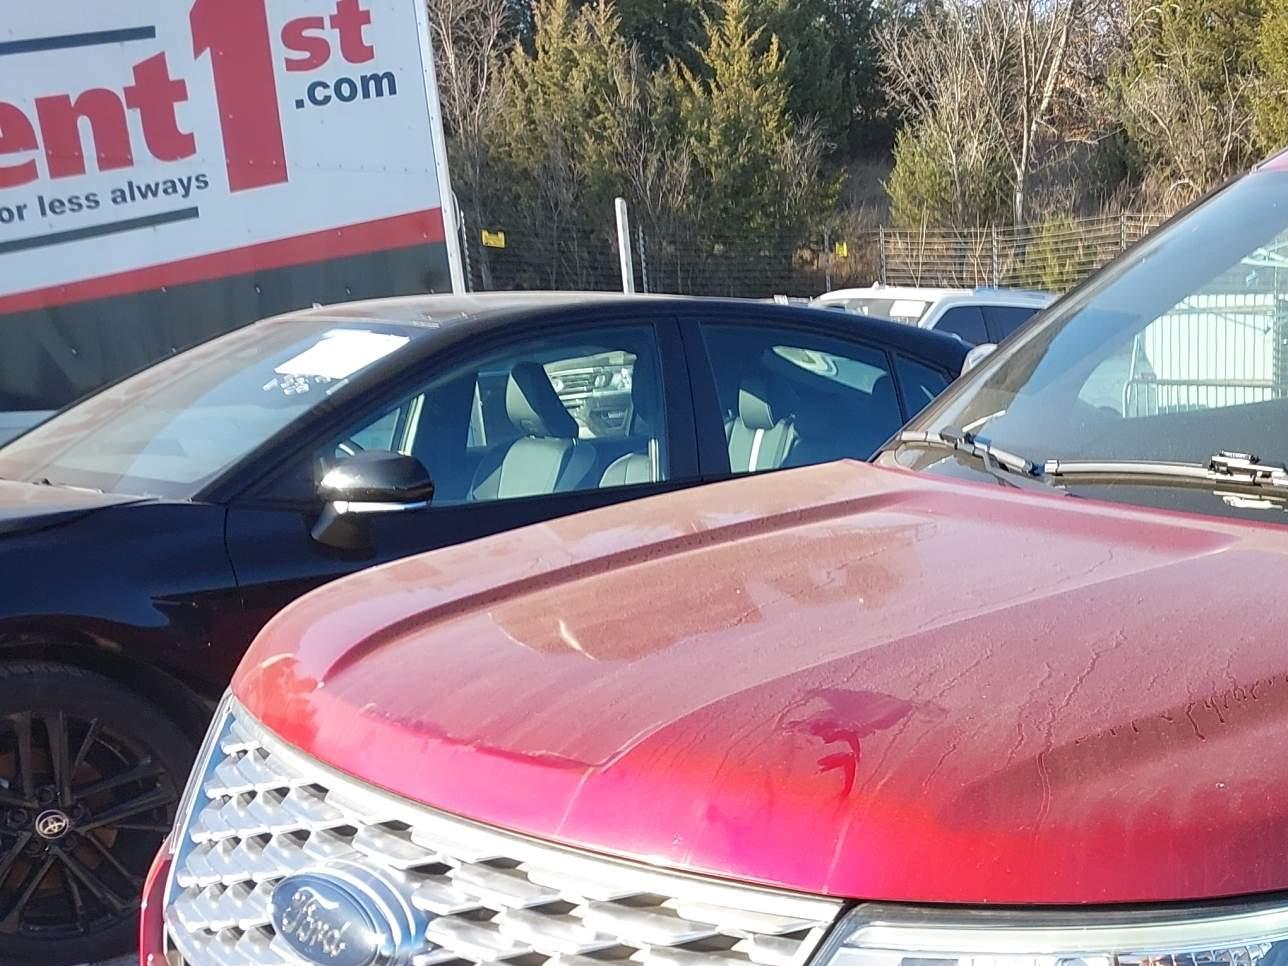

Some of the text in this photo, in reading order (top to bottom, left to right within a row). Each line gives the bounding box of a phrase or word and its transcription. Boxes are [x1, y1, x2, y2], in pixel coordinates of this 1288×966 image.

[295, 71, 397, 109] .com
[37, 192, 101, 218] less
[111, 173, 209, 205] always
[282, 886, 351, 958] Ford
